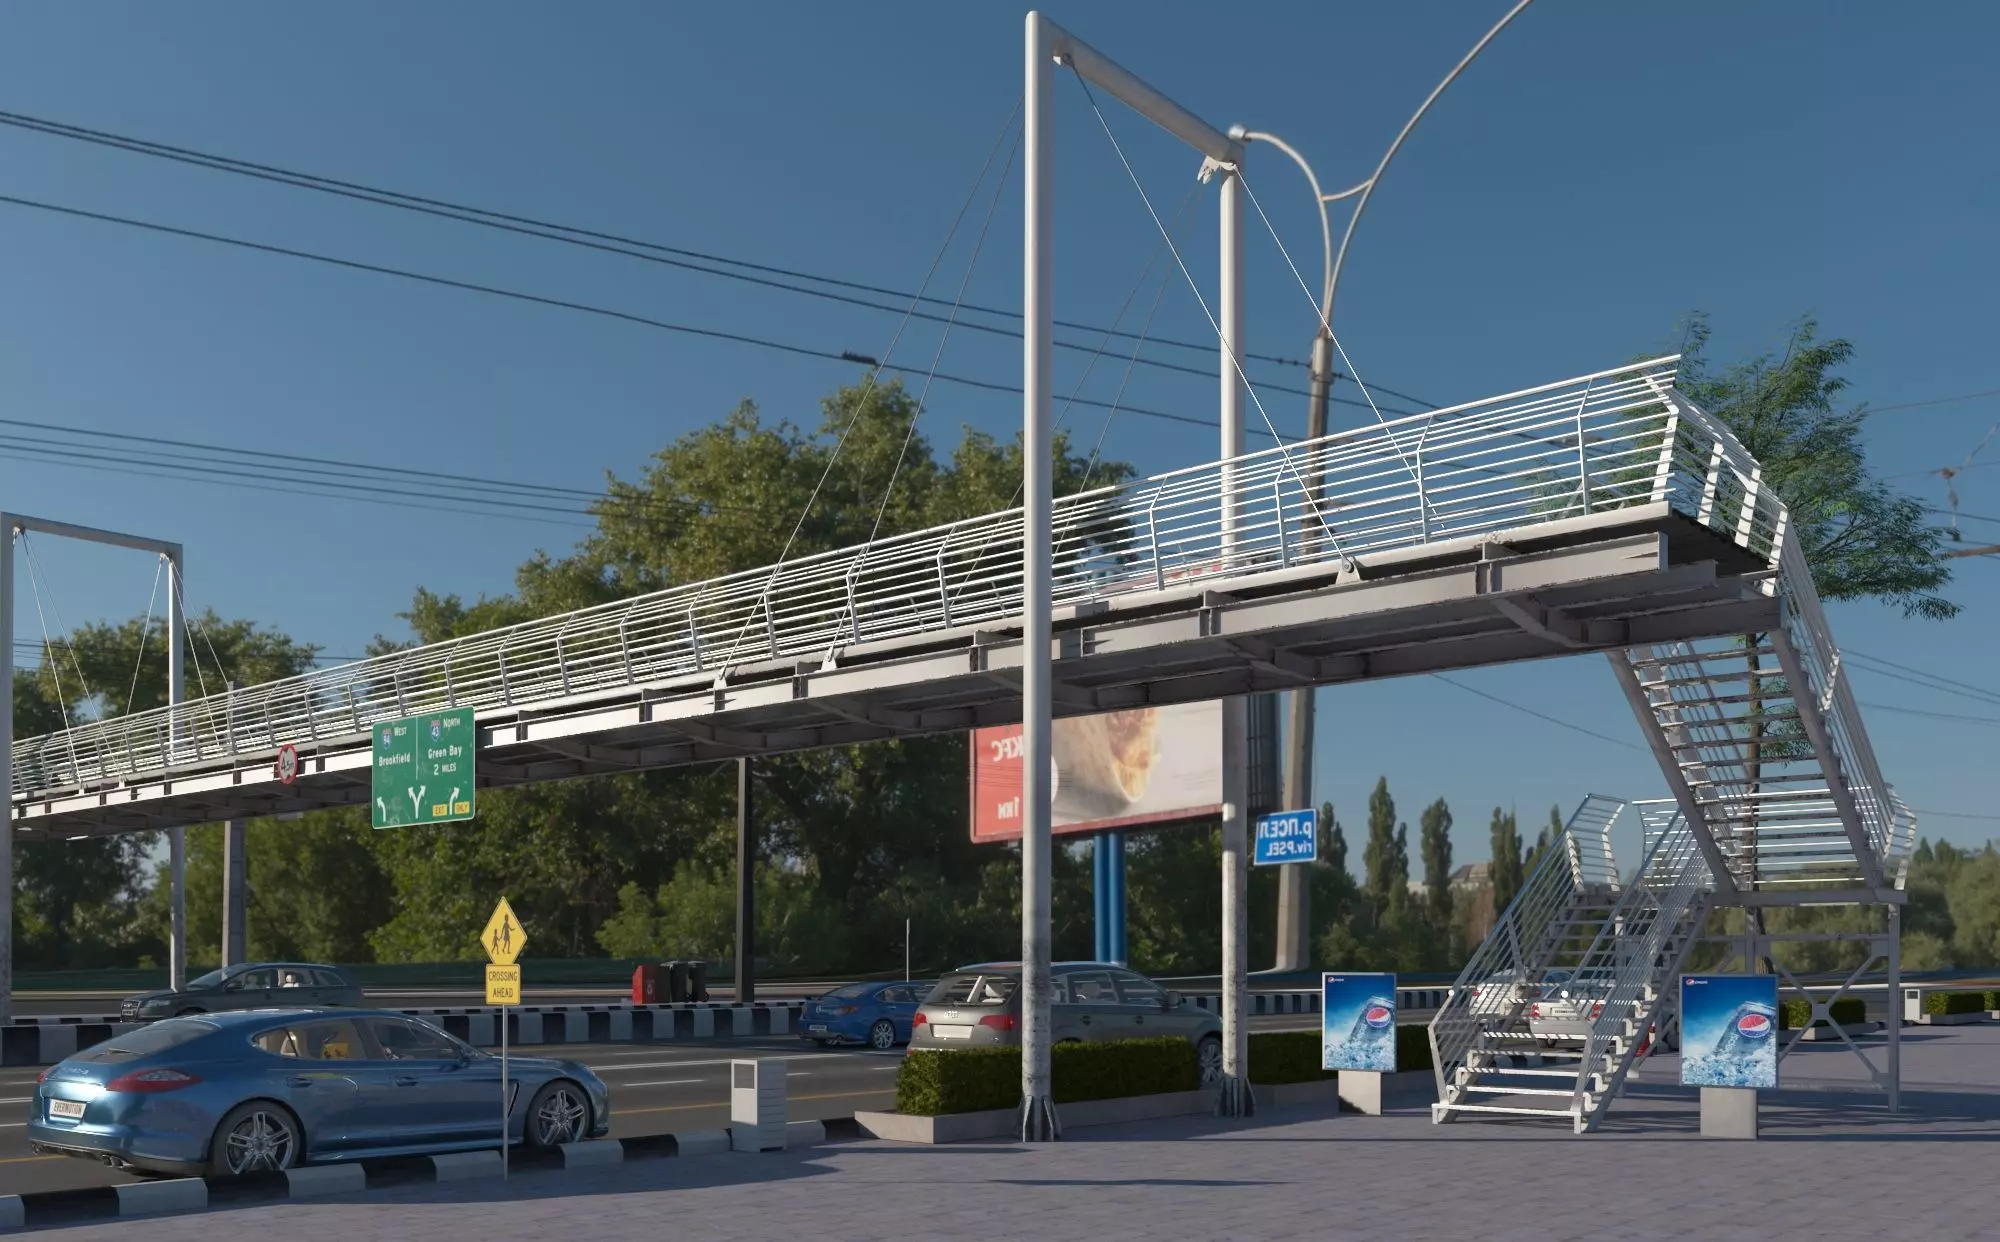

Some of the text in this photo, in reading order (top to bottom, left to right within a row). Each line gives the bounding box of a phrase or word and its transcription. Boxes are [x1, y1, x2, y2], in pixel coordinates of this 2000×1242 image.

[394, 726, 407, 736] WEST
[431, 717, 460, 737] 43 NORTH
[428, 744, 462, 760] Green Bay
[378, 752, 411, 767] Brookfield
[433, 762, 457, 776] 2 MILES
[488, 970, 518, 982] CROSSING
[492, 987, 513, 998] AHEAD
[53, 1101, 82, 1115] EVERMOTION
